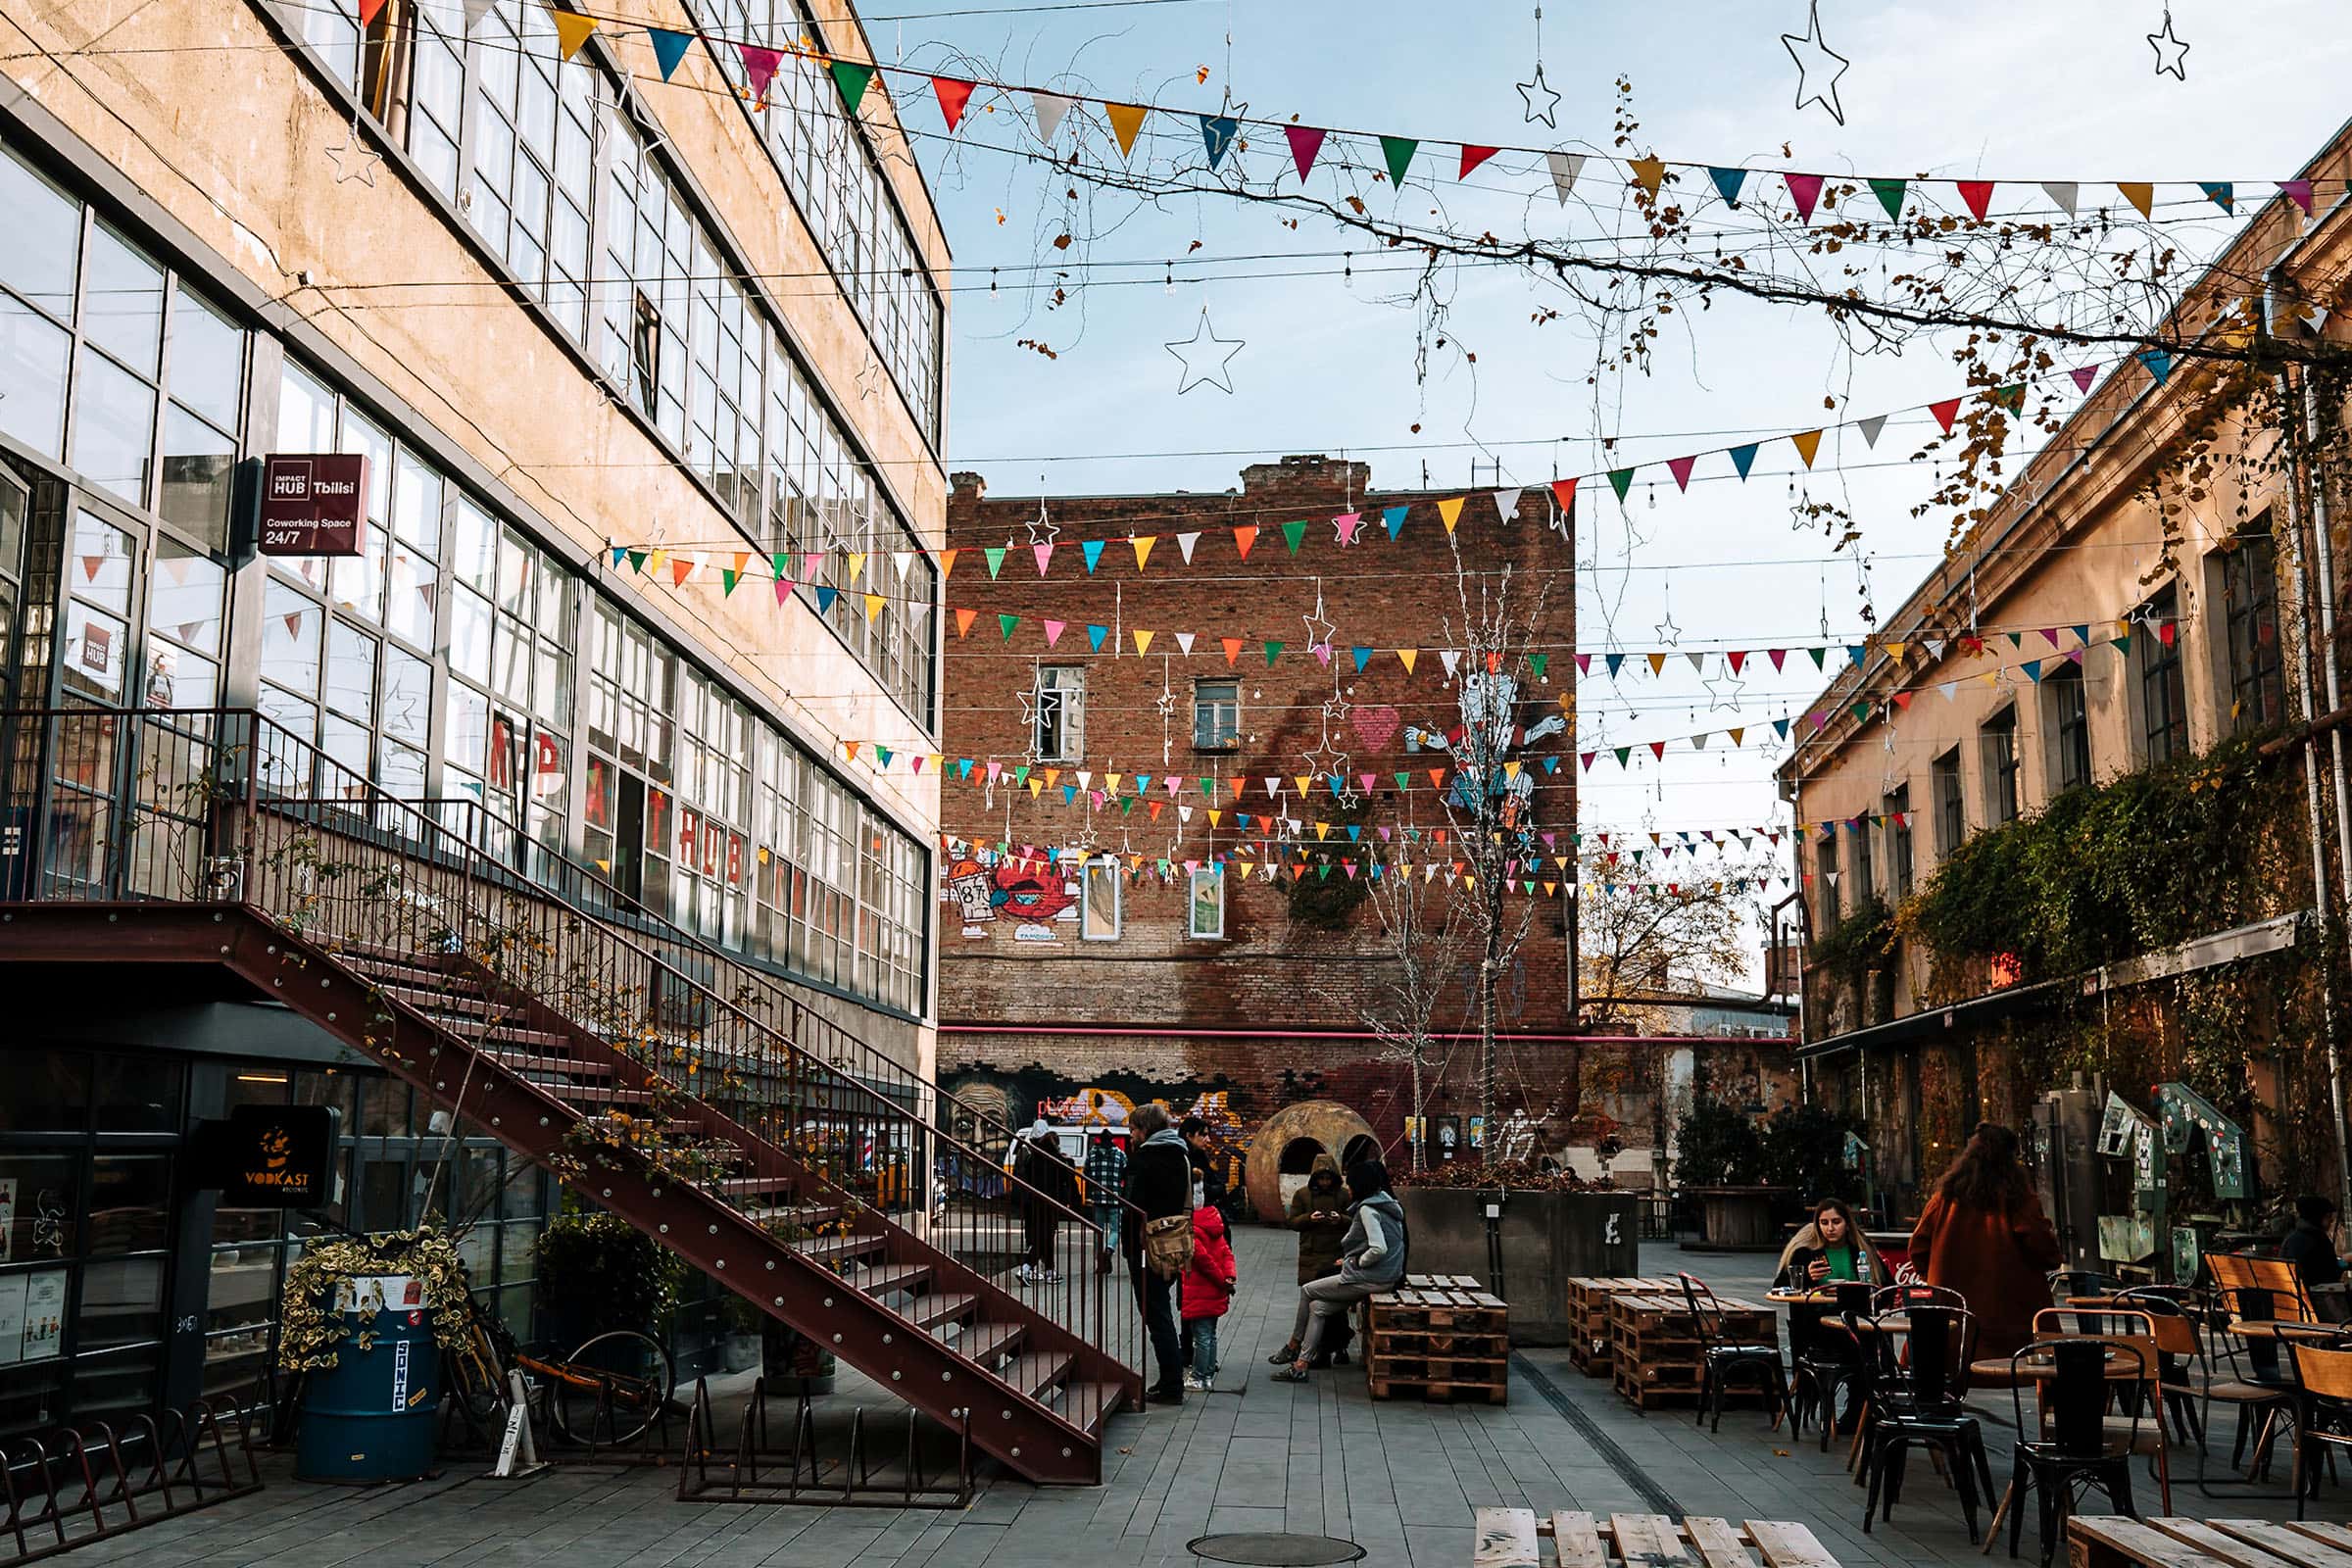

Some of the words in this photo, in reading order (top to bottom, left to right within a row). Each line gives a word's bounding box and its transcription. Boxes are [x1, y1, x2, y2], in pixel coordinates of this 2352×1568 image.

[274, 482, 306, 495] HUB
[313, 482, 355, 495] Tbilisi
[267, 518, 319, 529] Coworking
[320, 518, 352, 529] Space
[266, 531, 300, 545] 24/7
[85, 646, 106, 665] HUB
[679, 807, 742, 884] HUB
[245, 1169, 310, 1186] VODKAST
[394, 1343, 409, 1410] SONIC
